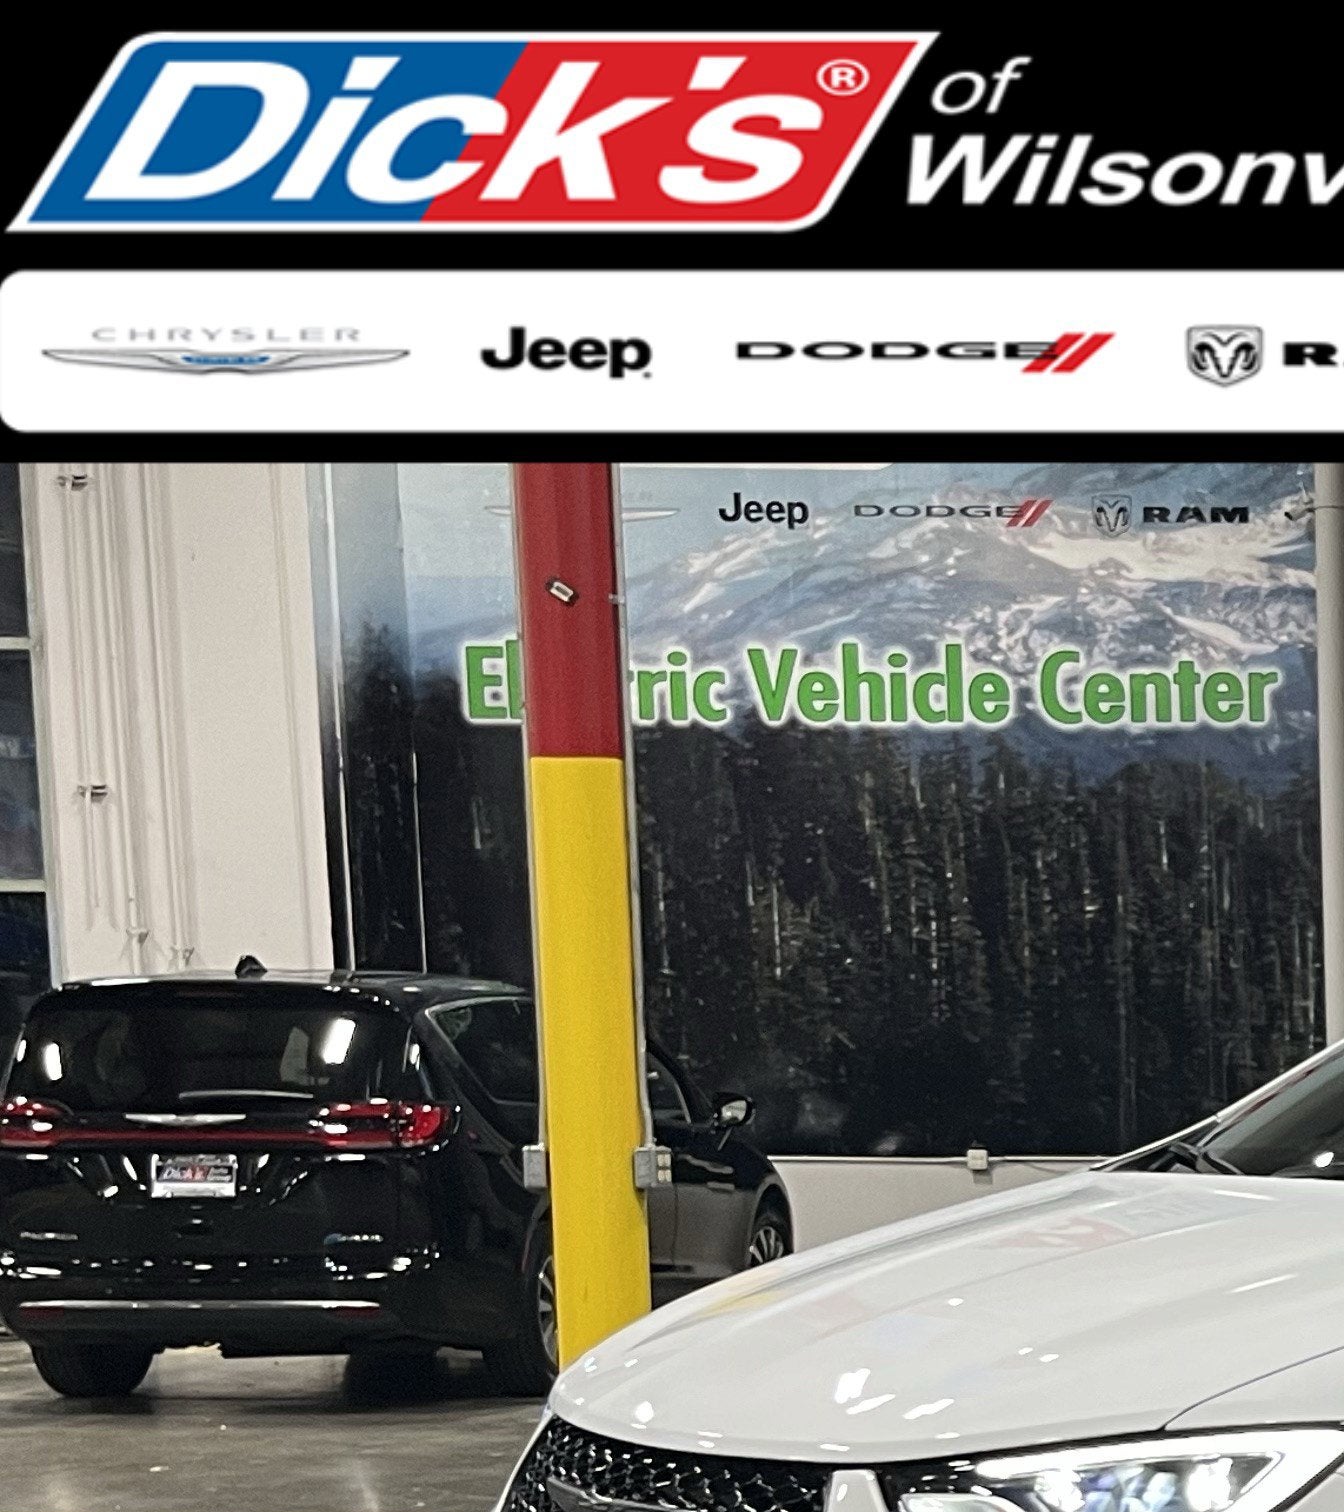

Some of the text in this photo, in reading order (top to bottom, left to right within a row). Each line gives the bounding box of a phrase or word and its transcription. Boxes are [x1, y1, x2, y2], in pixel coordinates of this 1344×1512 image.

[718, 492, 809, 529] Jeep
[853, 503, 1020, 519] DODGE
[1142, 505, 1250, 524] RAM
[464, 638, 1279, 723] Elric Vehicle Center
